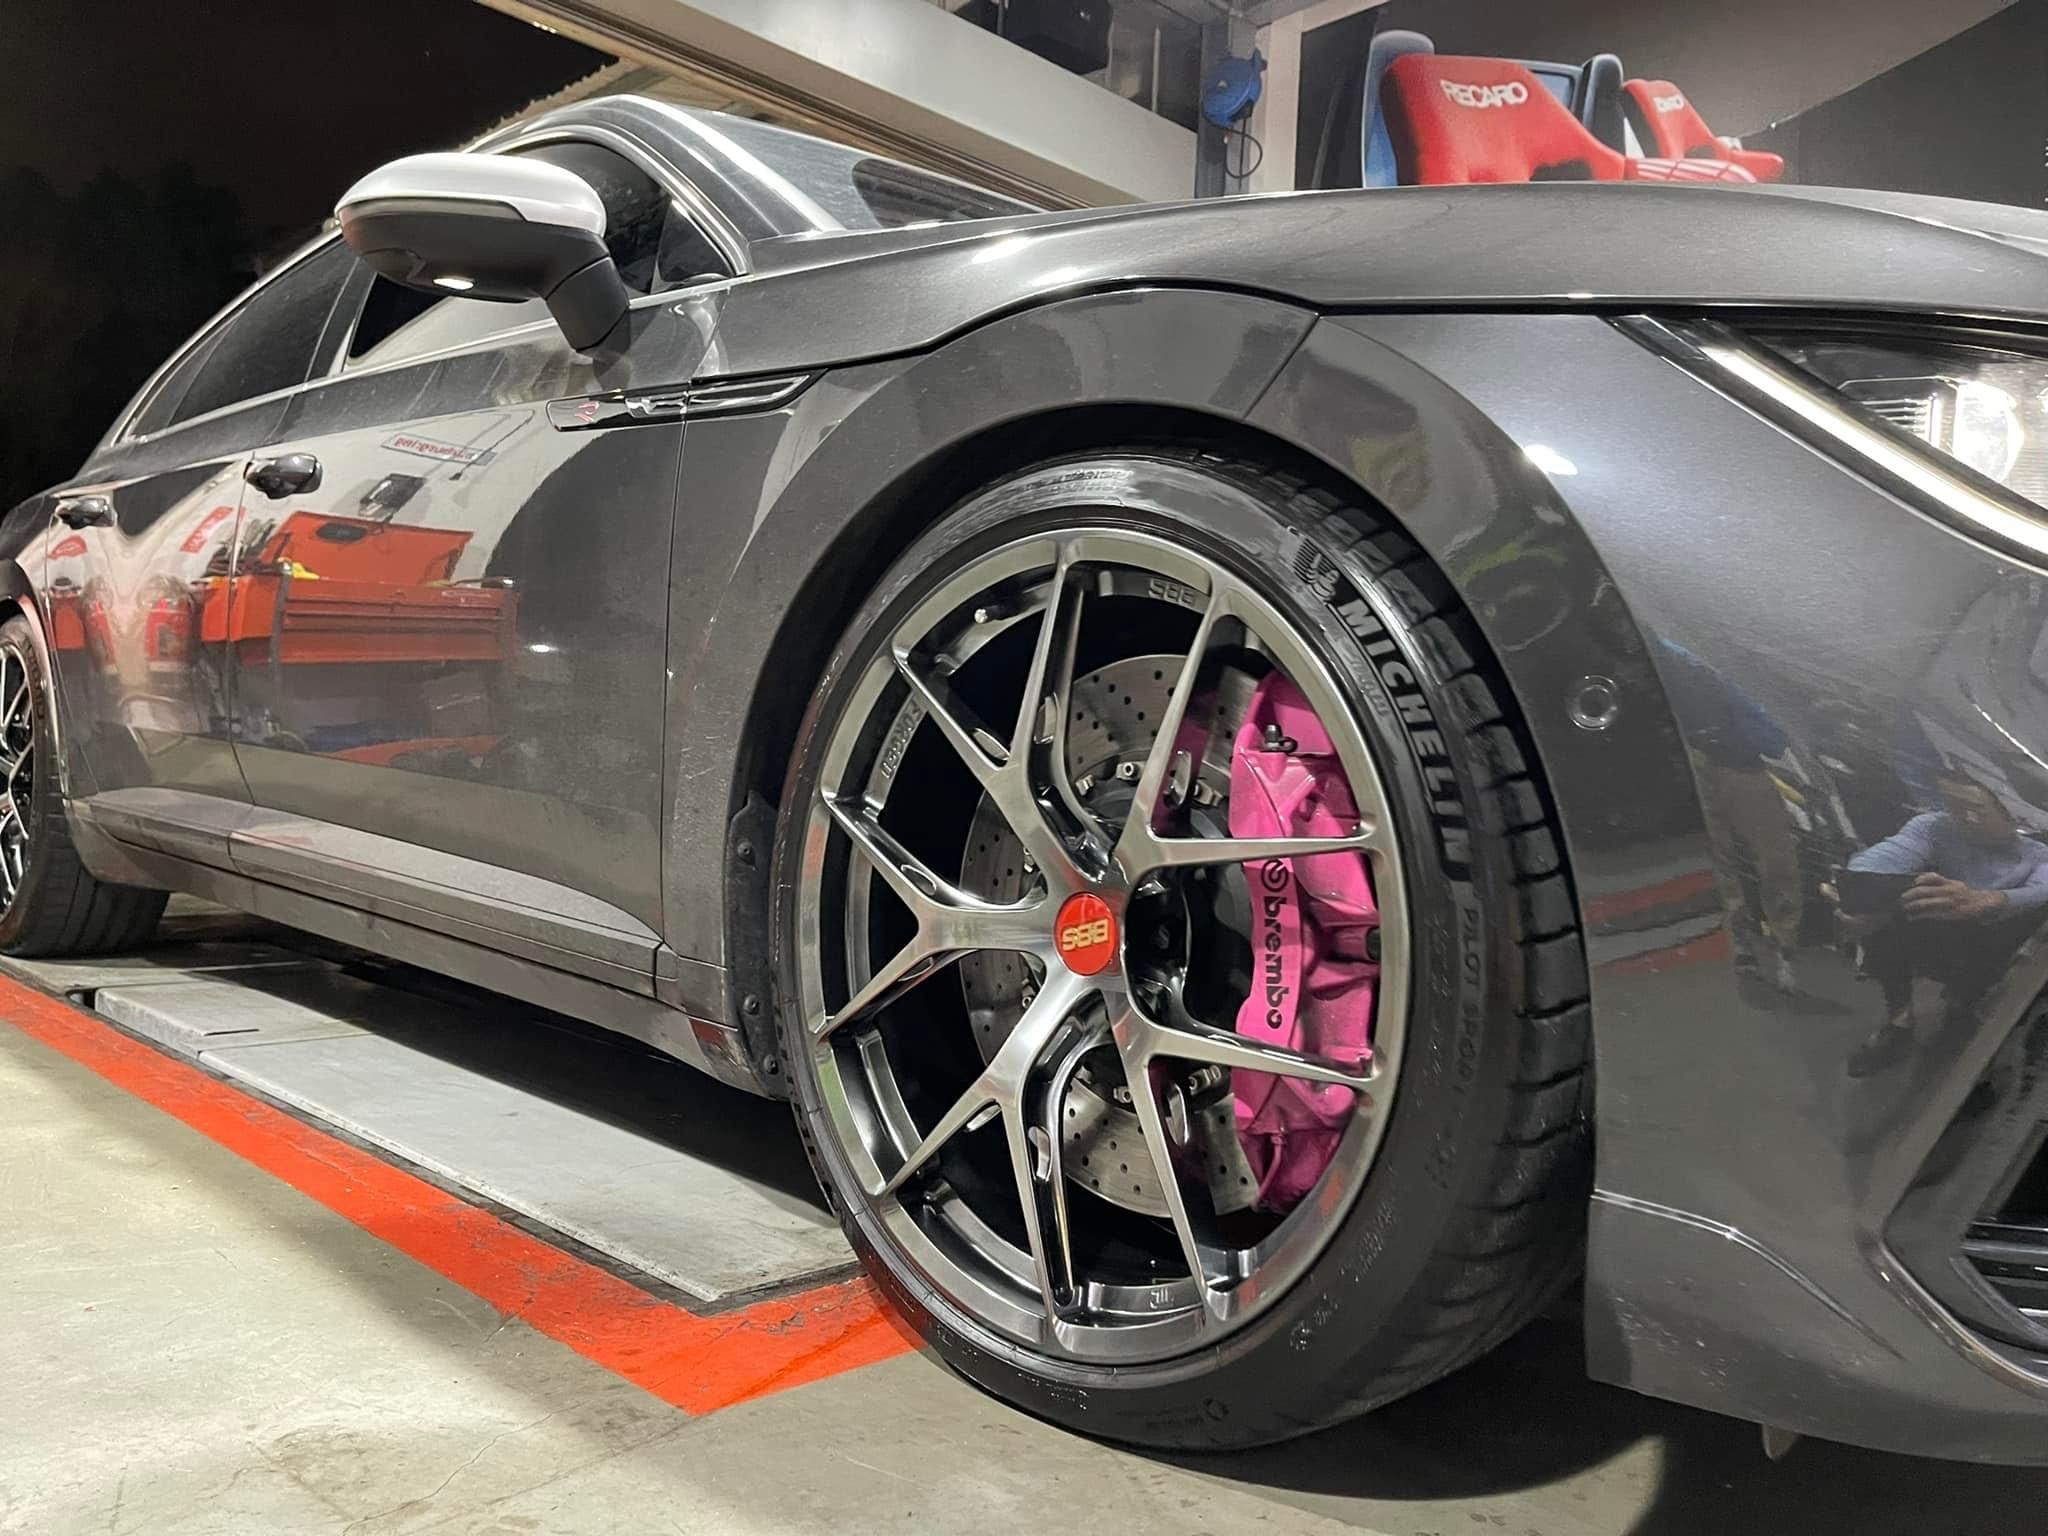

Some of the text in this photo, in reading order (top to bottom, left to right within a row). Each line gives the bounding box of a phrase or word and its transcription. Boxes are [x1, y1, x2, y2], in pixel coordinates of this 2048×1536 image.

[1440, 80, 1528, 109] RECARO
[1337, 599, 1470, 863] MICHELIN
[1062, 919, 1108, 951] BBS
[1263, 896, 1299, 1029] brembo
[1463, 906, 1480, 986] PILOT
